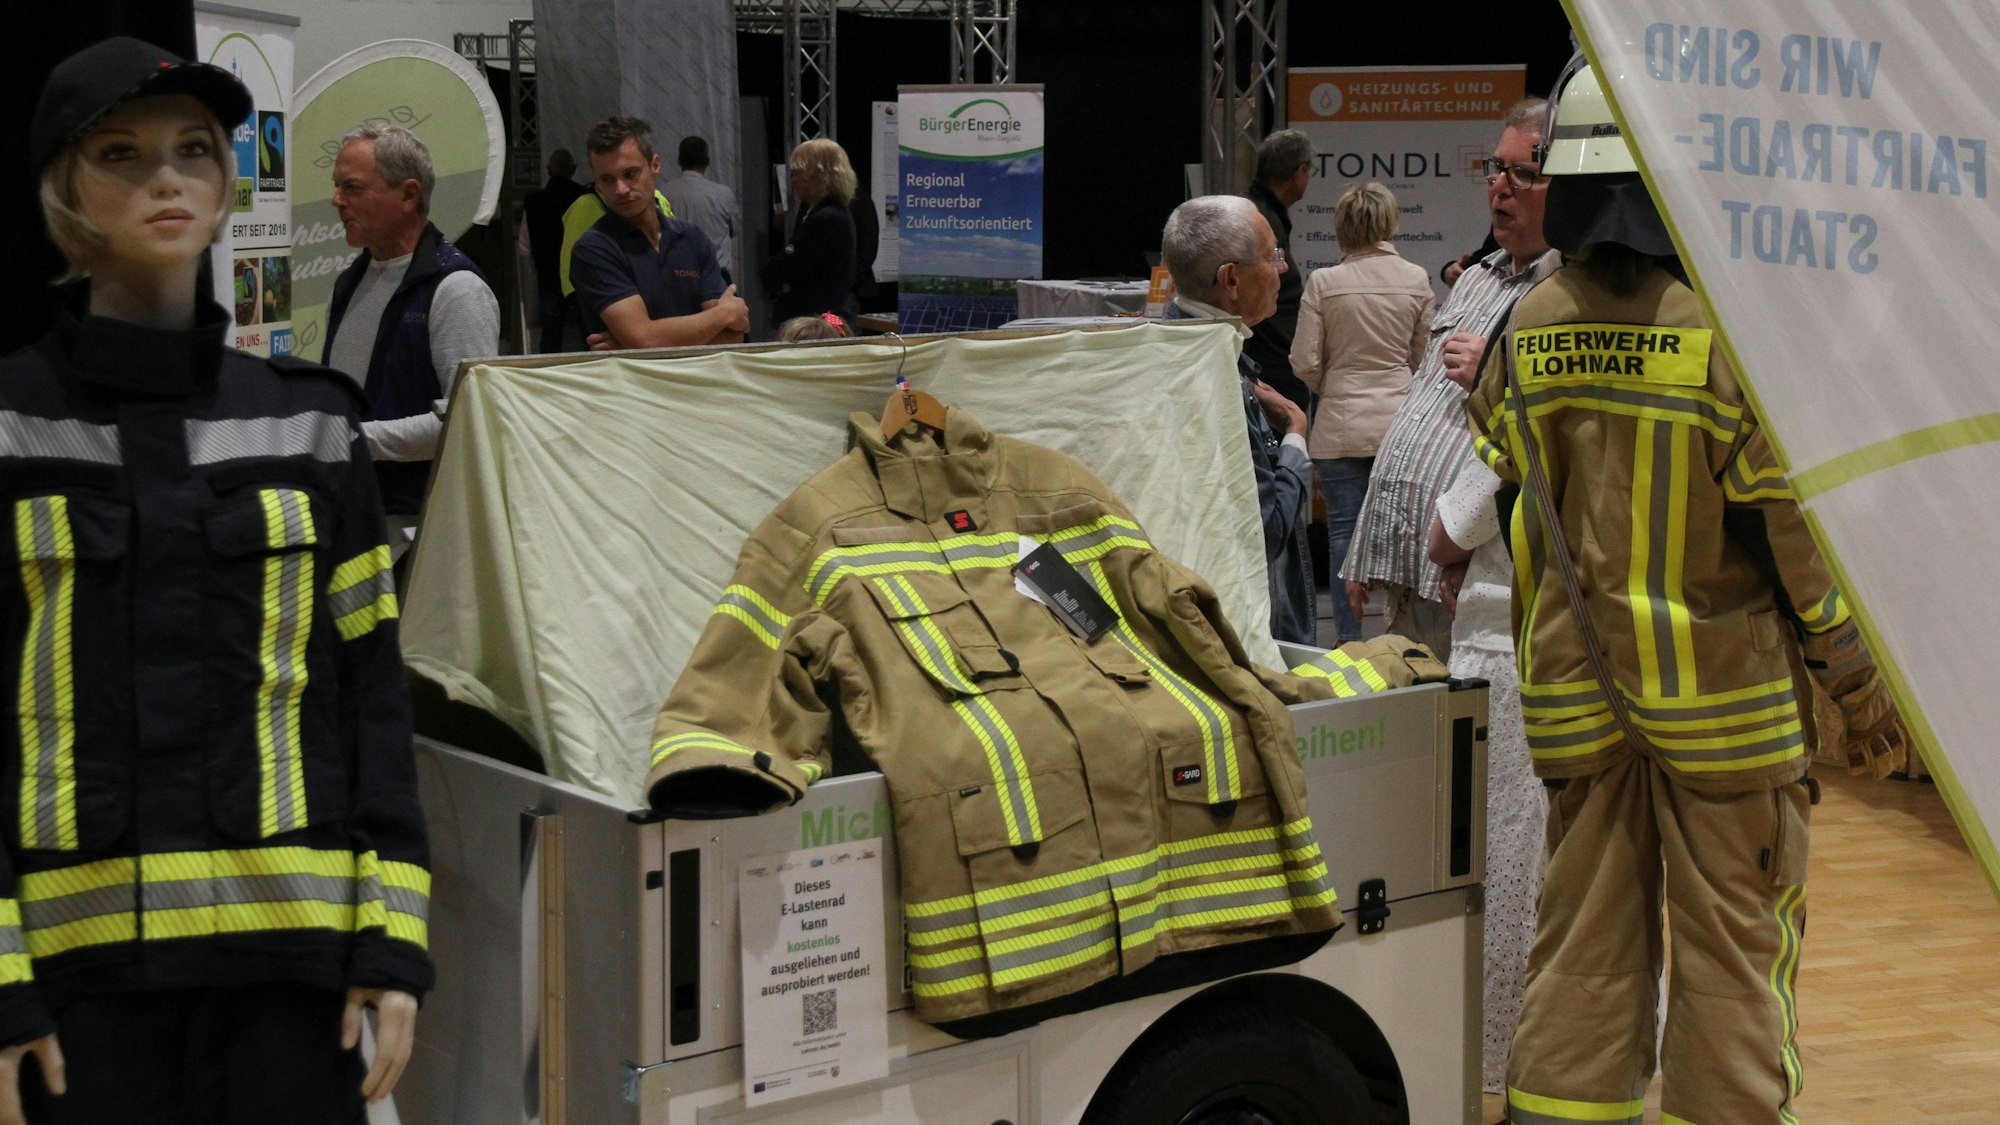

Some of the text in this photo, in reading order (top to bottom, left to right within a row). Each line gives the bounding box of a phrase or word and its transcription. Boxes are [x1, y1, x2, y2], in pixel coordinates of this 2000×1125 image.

[1349, 81, 1494, 96] HEIZUNGS- UND
[1348, 98, 1501, 114] SANITÄRTECHNIK
[919, 117, 1022, 134] BürgerEnergie
[1591, 123, 1621, 136] Bulla
[1316, 152, 1452, 178] TONDL
[259, 177, 285, 188] FAIRTRADE
[906, 173, 965, 189] Regional
[906, 194, 982, 209] Erneuerbar
[1306, 204, 1424, 214] Wärm welt
[233, 223, 287, 238] ERT SEIT 2018
[905, 215, 1033, 231] Zukunftsorientiert
[1306, 231, 1444, 242] Effizie erttechnik
[235, 335, 245, 349] EN
[1517, 330, 1681, 357] FEUERWEHR
[1532, 354, 1645, 377] LOHMAR
[1296, 712, 1388, 760] eihen!
[794, 879, 831, 895] Dieses
[781, 893, 846, 916] E-Lastenrad
[801, 917, 828, 932] kann
[786, 933, 841, 953] kostenlos
[771, 947, 861, 976] ausgeliehen und
[761, 963, 871, 997] ausprobiert werden!
